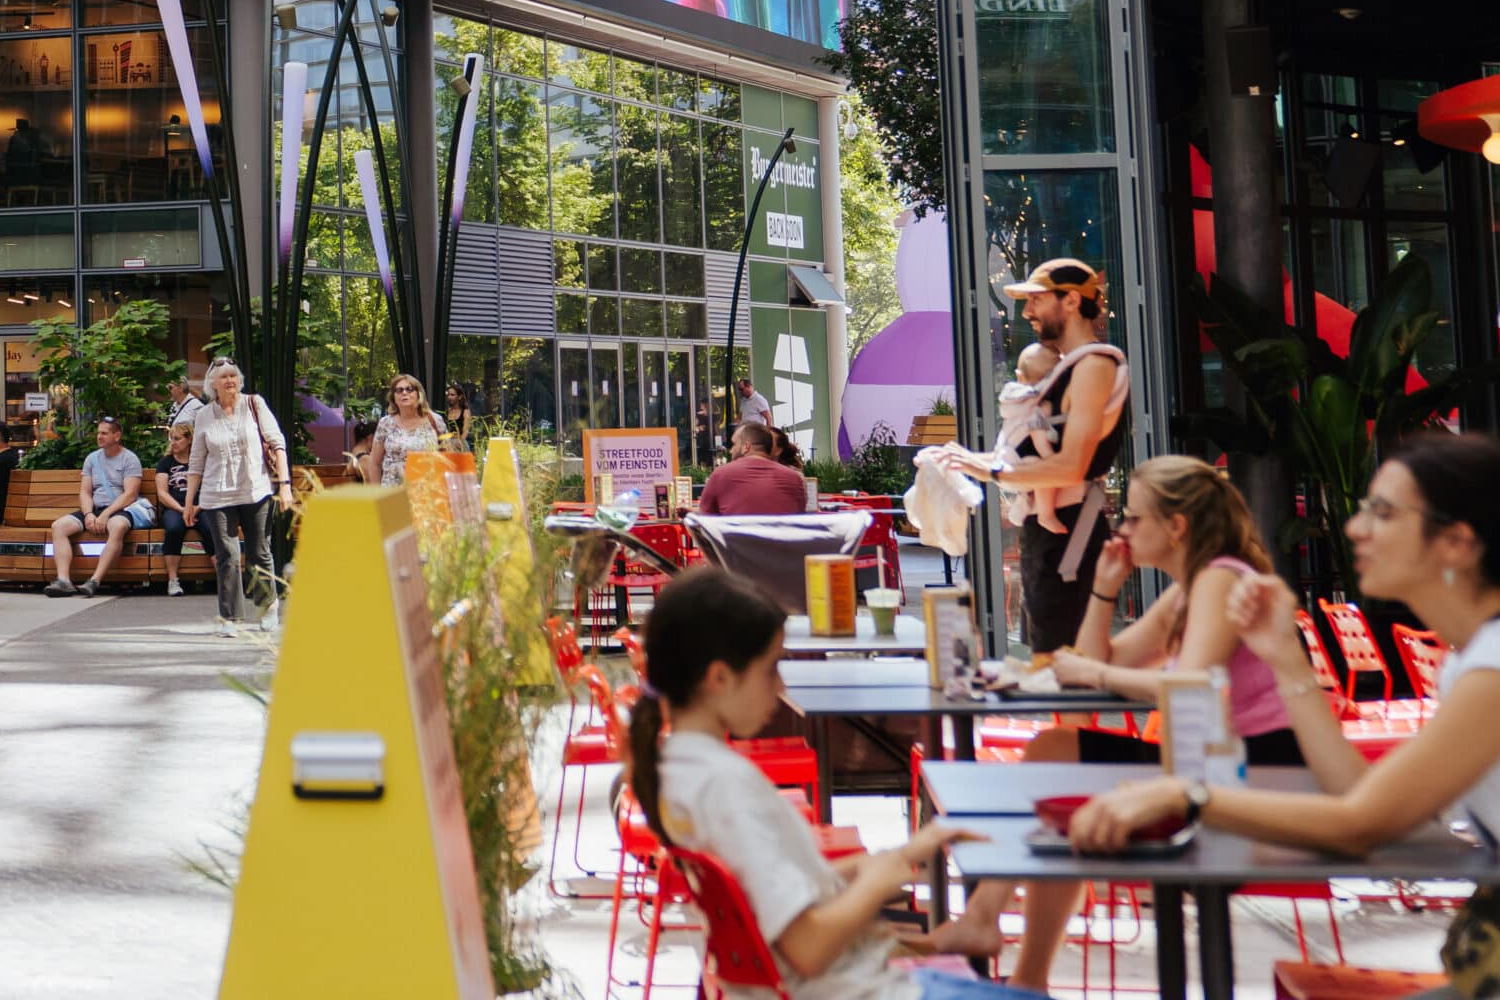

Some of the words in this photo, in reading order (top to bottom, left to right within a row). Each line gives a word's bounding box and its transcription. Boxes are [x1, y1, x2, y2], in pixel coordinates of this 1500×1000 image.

[599, 448, 663, 459] STREETFOOD
[596, 460, 618, 470] VOM
[620, 460, 667, 470] FEINSTEN
